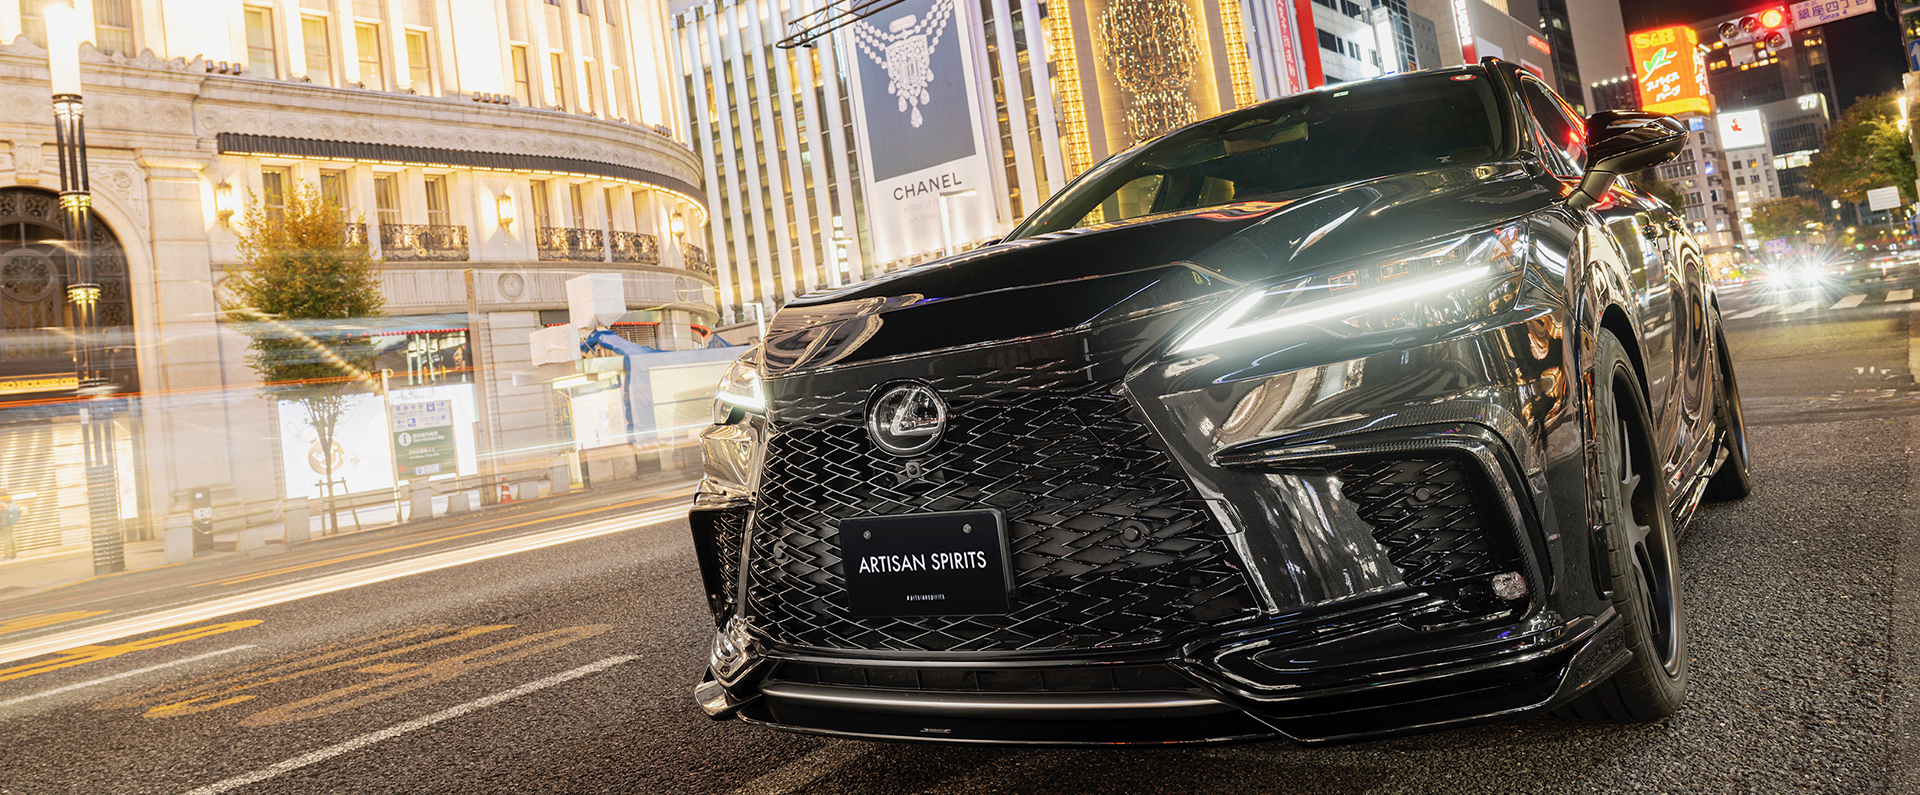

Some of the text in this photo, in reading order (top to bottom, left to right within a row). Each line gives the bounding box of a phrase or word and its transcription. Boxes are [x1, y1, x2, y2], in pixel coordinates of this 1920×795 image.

[1820, 12, 1840, 21] Ginza
[1634, 28, 1676, 49] S&B
[1645, 71, 1680, 92] スパイス
[893, 172, 963, 201] CHANEL
[904, 201, 924, 213] HIGH
[16, 378, 60, 389] HOUSE
[859, 551, 987, 574] ARTISAN SPIRITS
